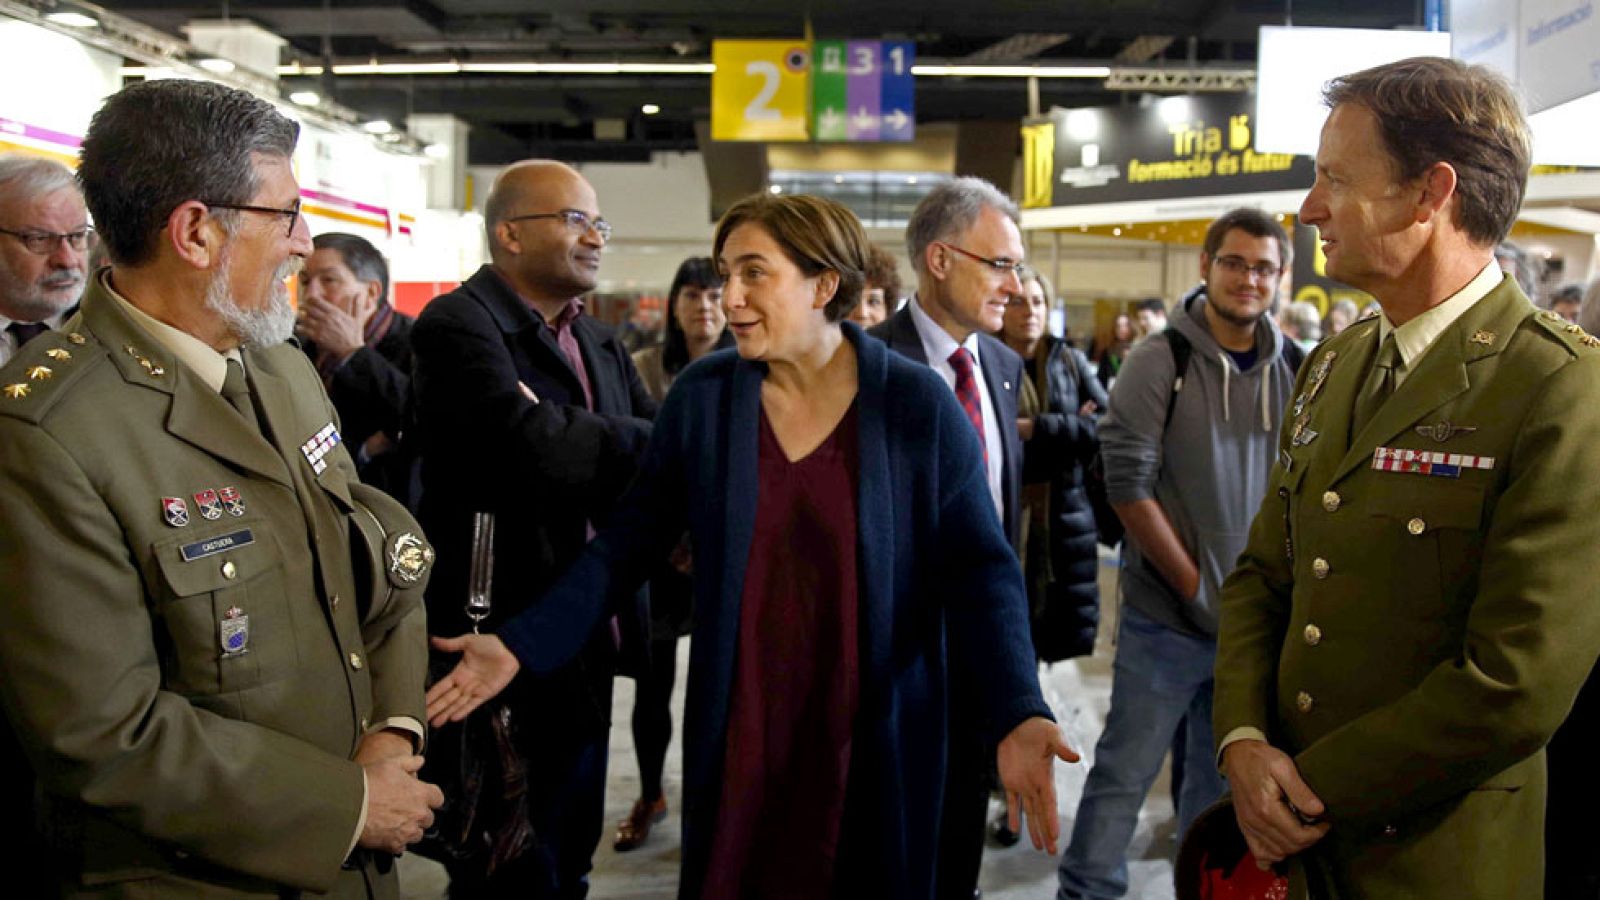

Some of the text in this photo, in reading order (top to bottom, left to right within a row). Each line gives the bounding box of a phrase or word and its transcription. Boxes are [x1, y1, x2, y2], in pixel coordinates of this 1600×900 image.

[854, 48, 904, 75] 3 1
[744, 60, 782, 121] 2
[1169, 121, 1222, 157] Tria
[1128, 154, 1213, 183] formació
